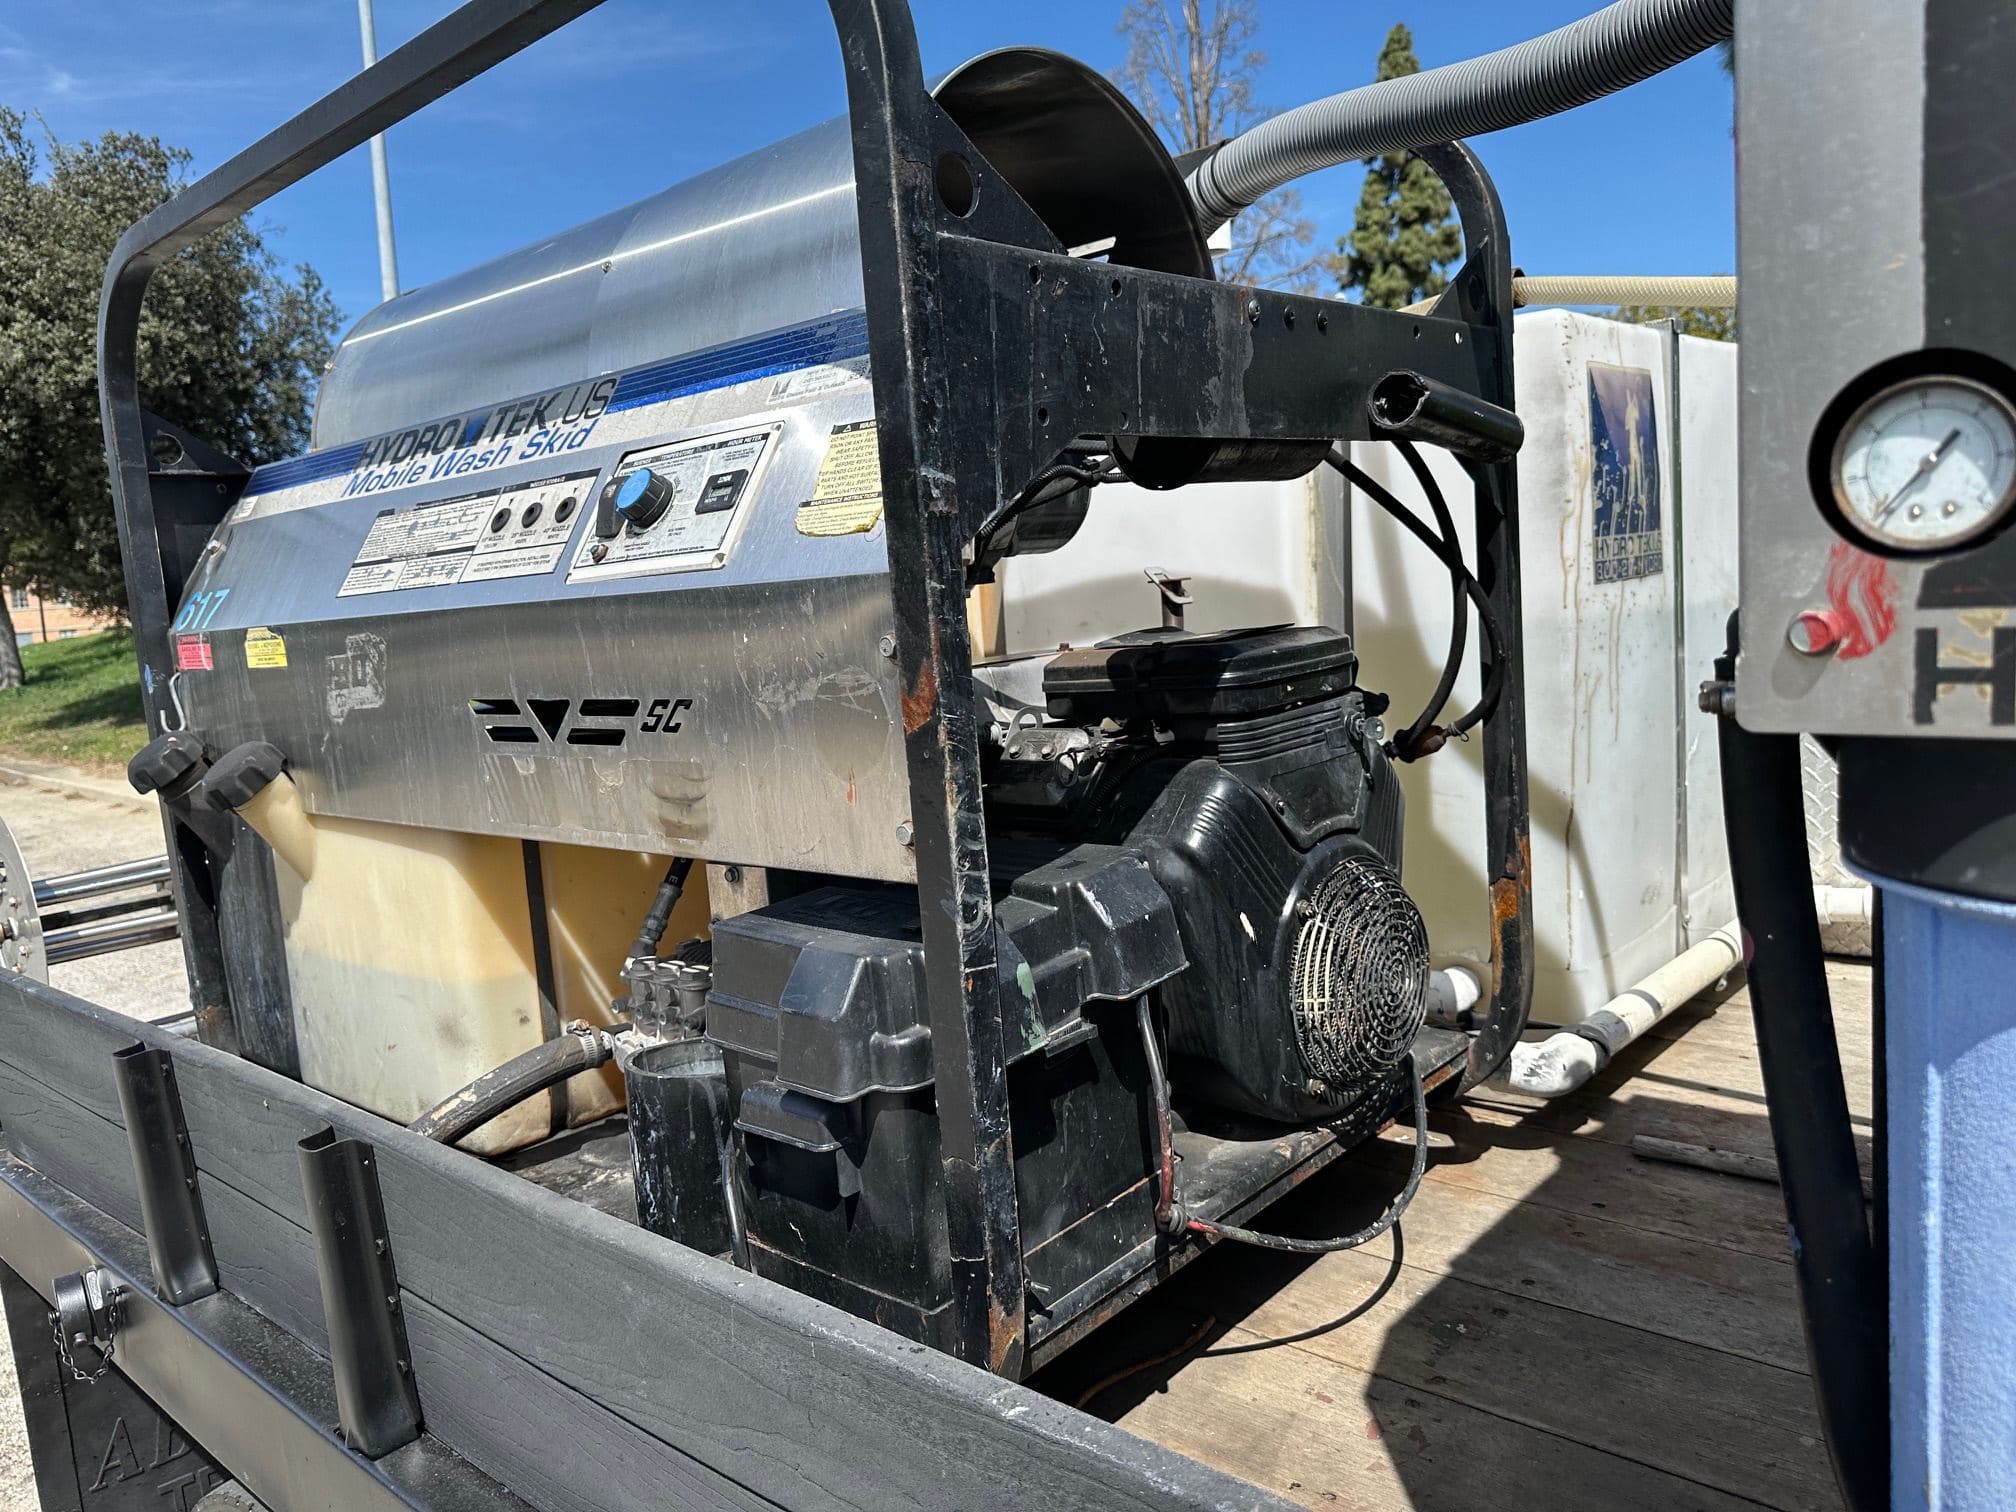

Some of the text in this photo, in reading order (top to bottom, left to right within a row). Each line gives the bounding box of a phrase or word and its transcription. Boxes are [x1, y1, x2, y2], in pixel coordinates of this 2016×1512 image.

[341, 420, 598, 498] Mobile Wash Skid
[355, 419, 461, 472] HYDRO
[176, 588, 231, 631] 617
[640, 698, 693, 733] SC
